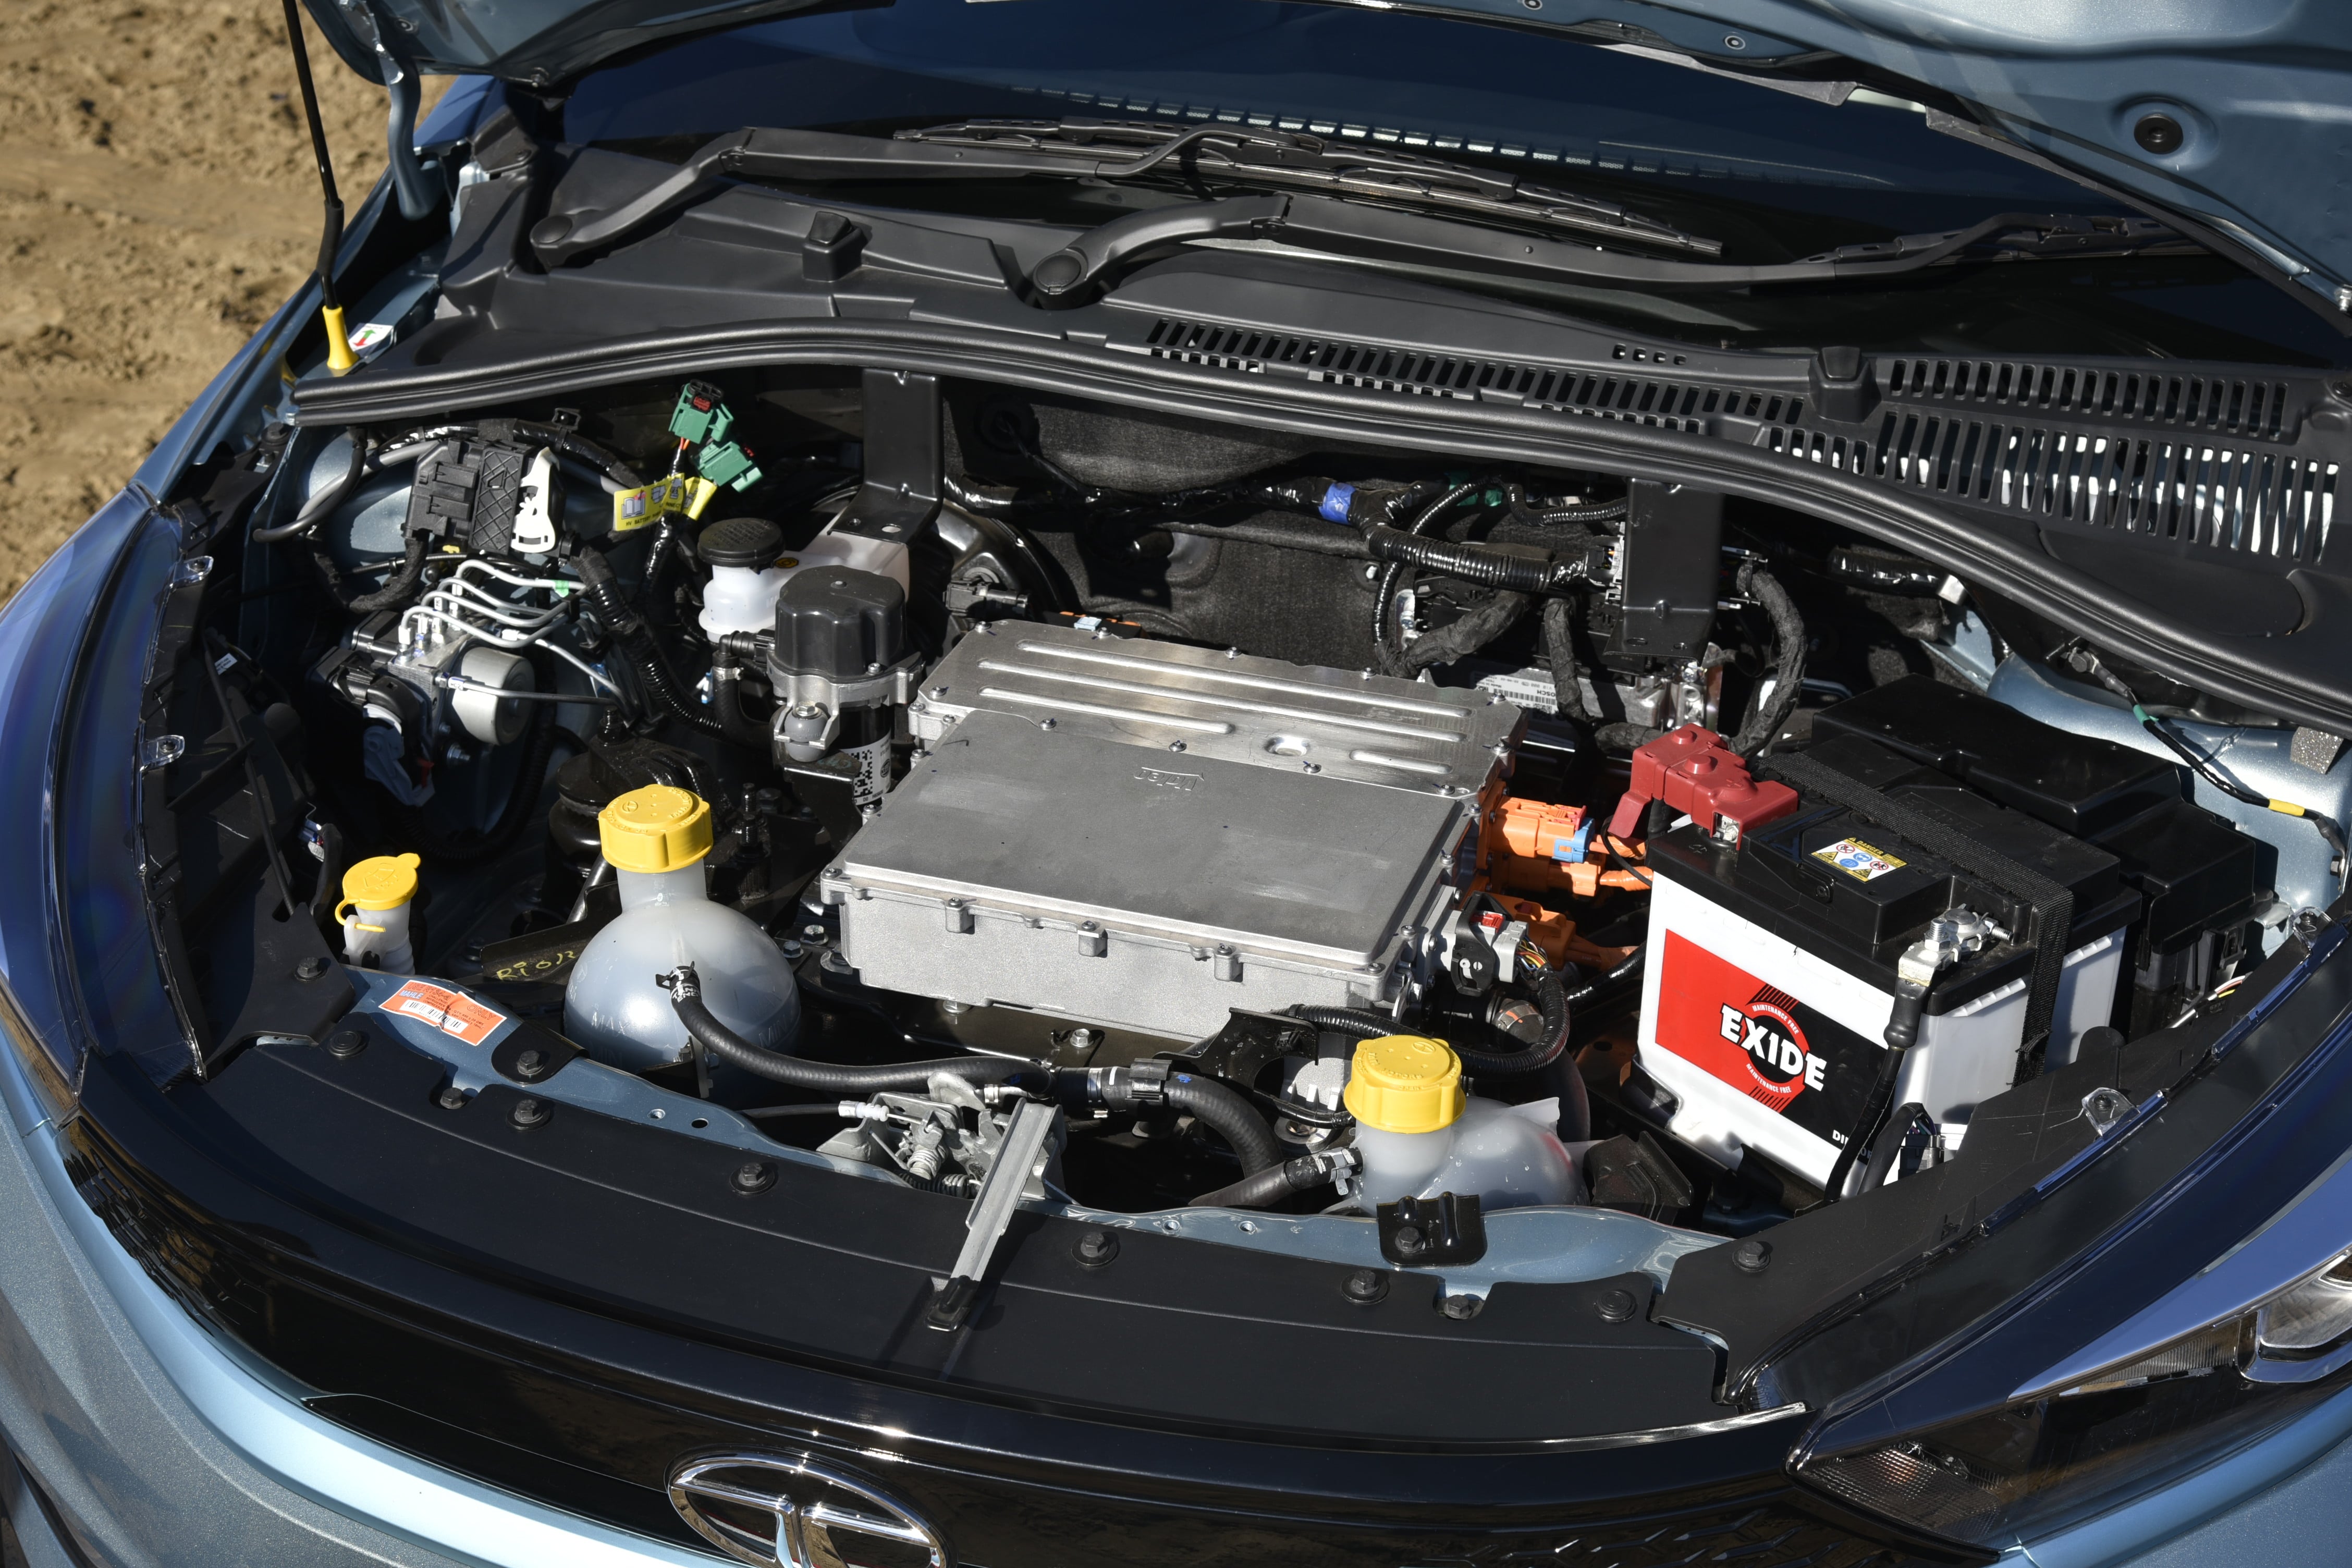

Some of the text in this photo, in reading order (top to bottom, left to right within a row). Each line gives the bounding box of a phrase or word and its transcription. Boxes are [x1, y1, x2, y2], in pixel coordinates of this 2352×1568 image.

[1856, 840, 1884, 855] DANGER
[400, 989, 424, 999] MAHLE
[467, 1004, 496, 1020] ONLY
[1752, 1004, 1799, 1035] MAINTENANCE FREE
[1721, 1003, 1827, 1092] EXIDE
[1746, 1063, 1779, 1093] MAINTENANCE
